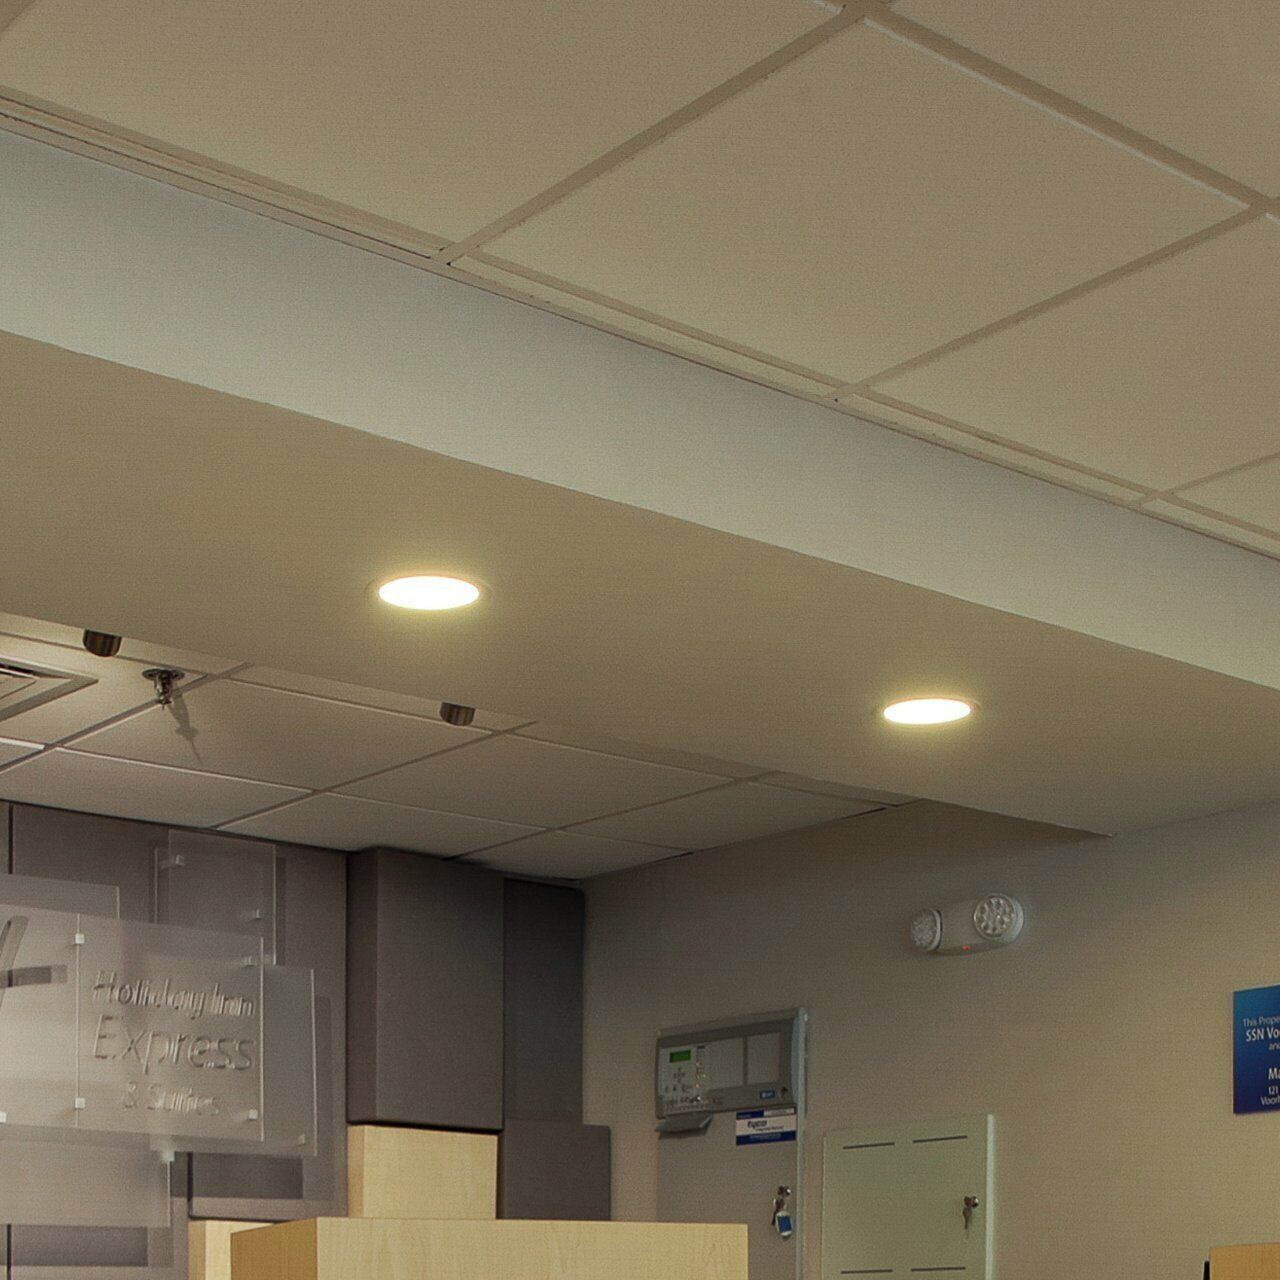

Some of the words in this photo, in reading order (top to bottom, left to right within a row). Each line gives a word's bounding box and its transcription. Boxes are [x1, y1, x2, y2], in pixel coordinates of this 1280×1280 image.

[94, 970, 207, 1020] Holiday
[1243, 1018, 1257, 1027] This
[94, 1014, 255, 1075] Express
[1246, 1028, 1265, 1042] SSN
[146, 1083, 221, 1116] Suites
[1268, 1084, 1279, 1095] 121
